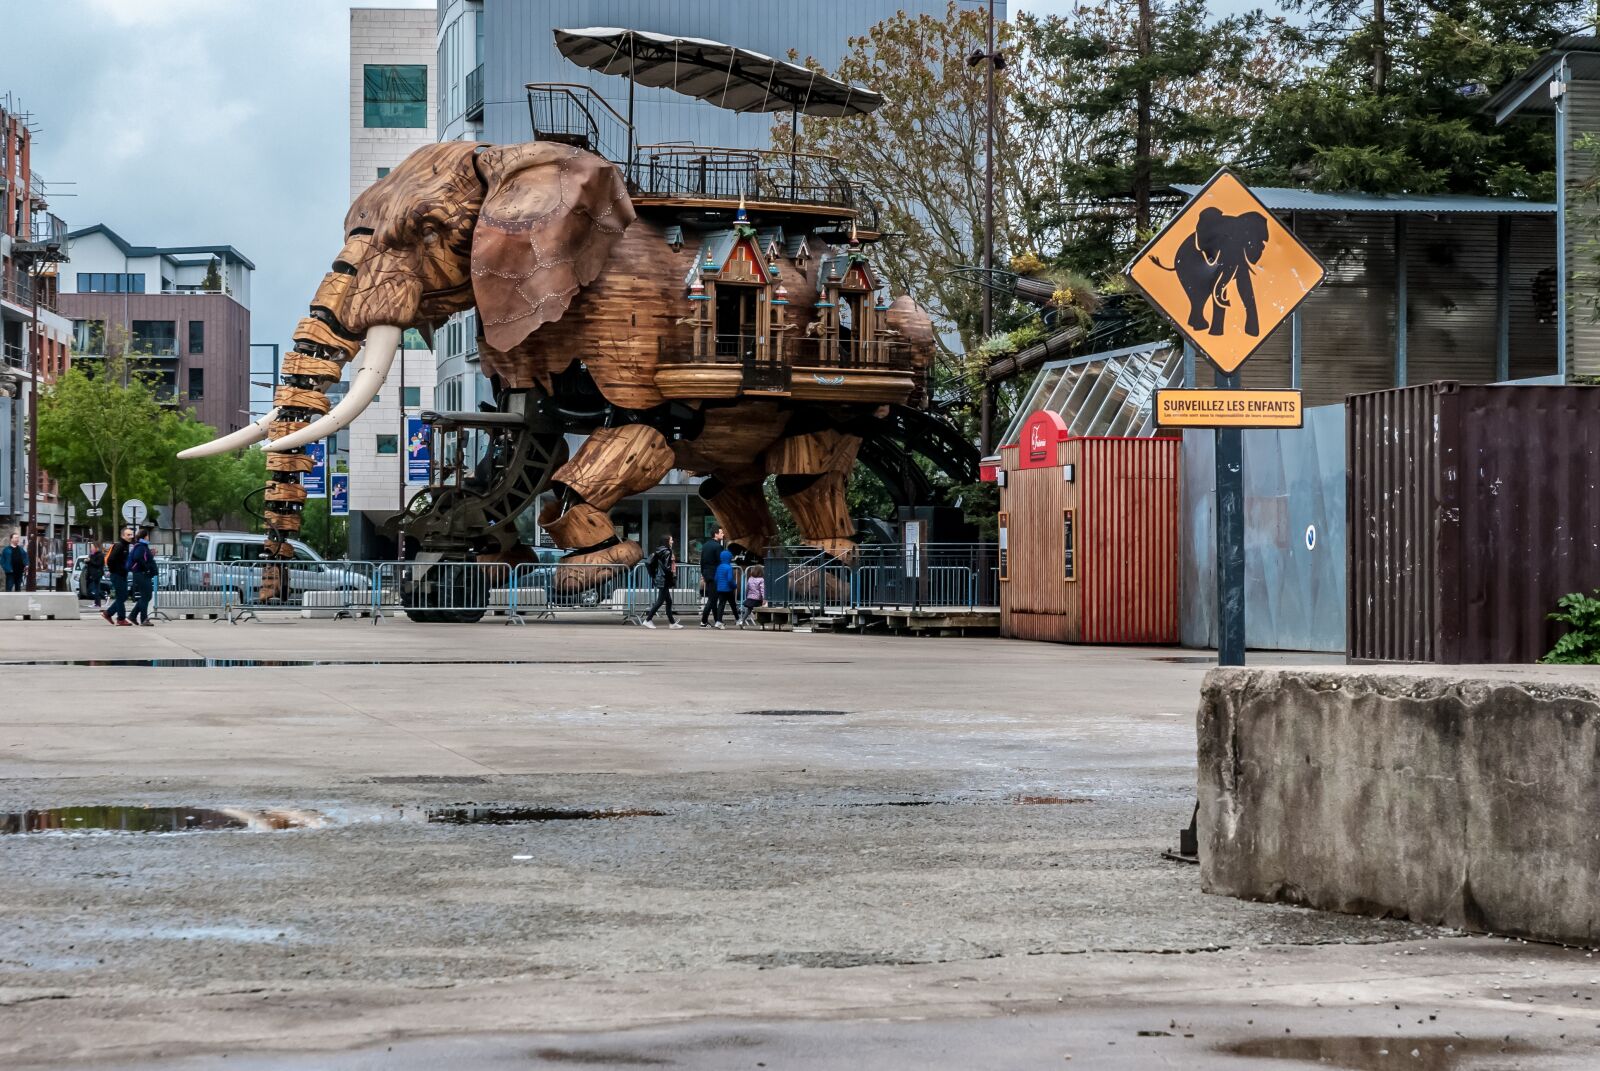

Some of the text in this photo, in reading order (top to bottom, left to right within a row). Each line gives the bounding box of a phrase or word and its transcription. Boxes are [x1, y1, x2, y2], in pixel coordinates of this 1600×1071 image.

[1163, 400, 1295, 412] SURVEILLEZ LES ENFANTS
